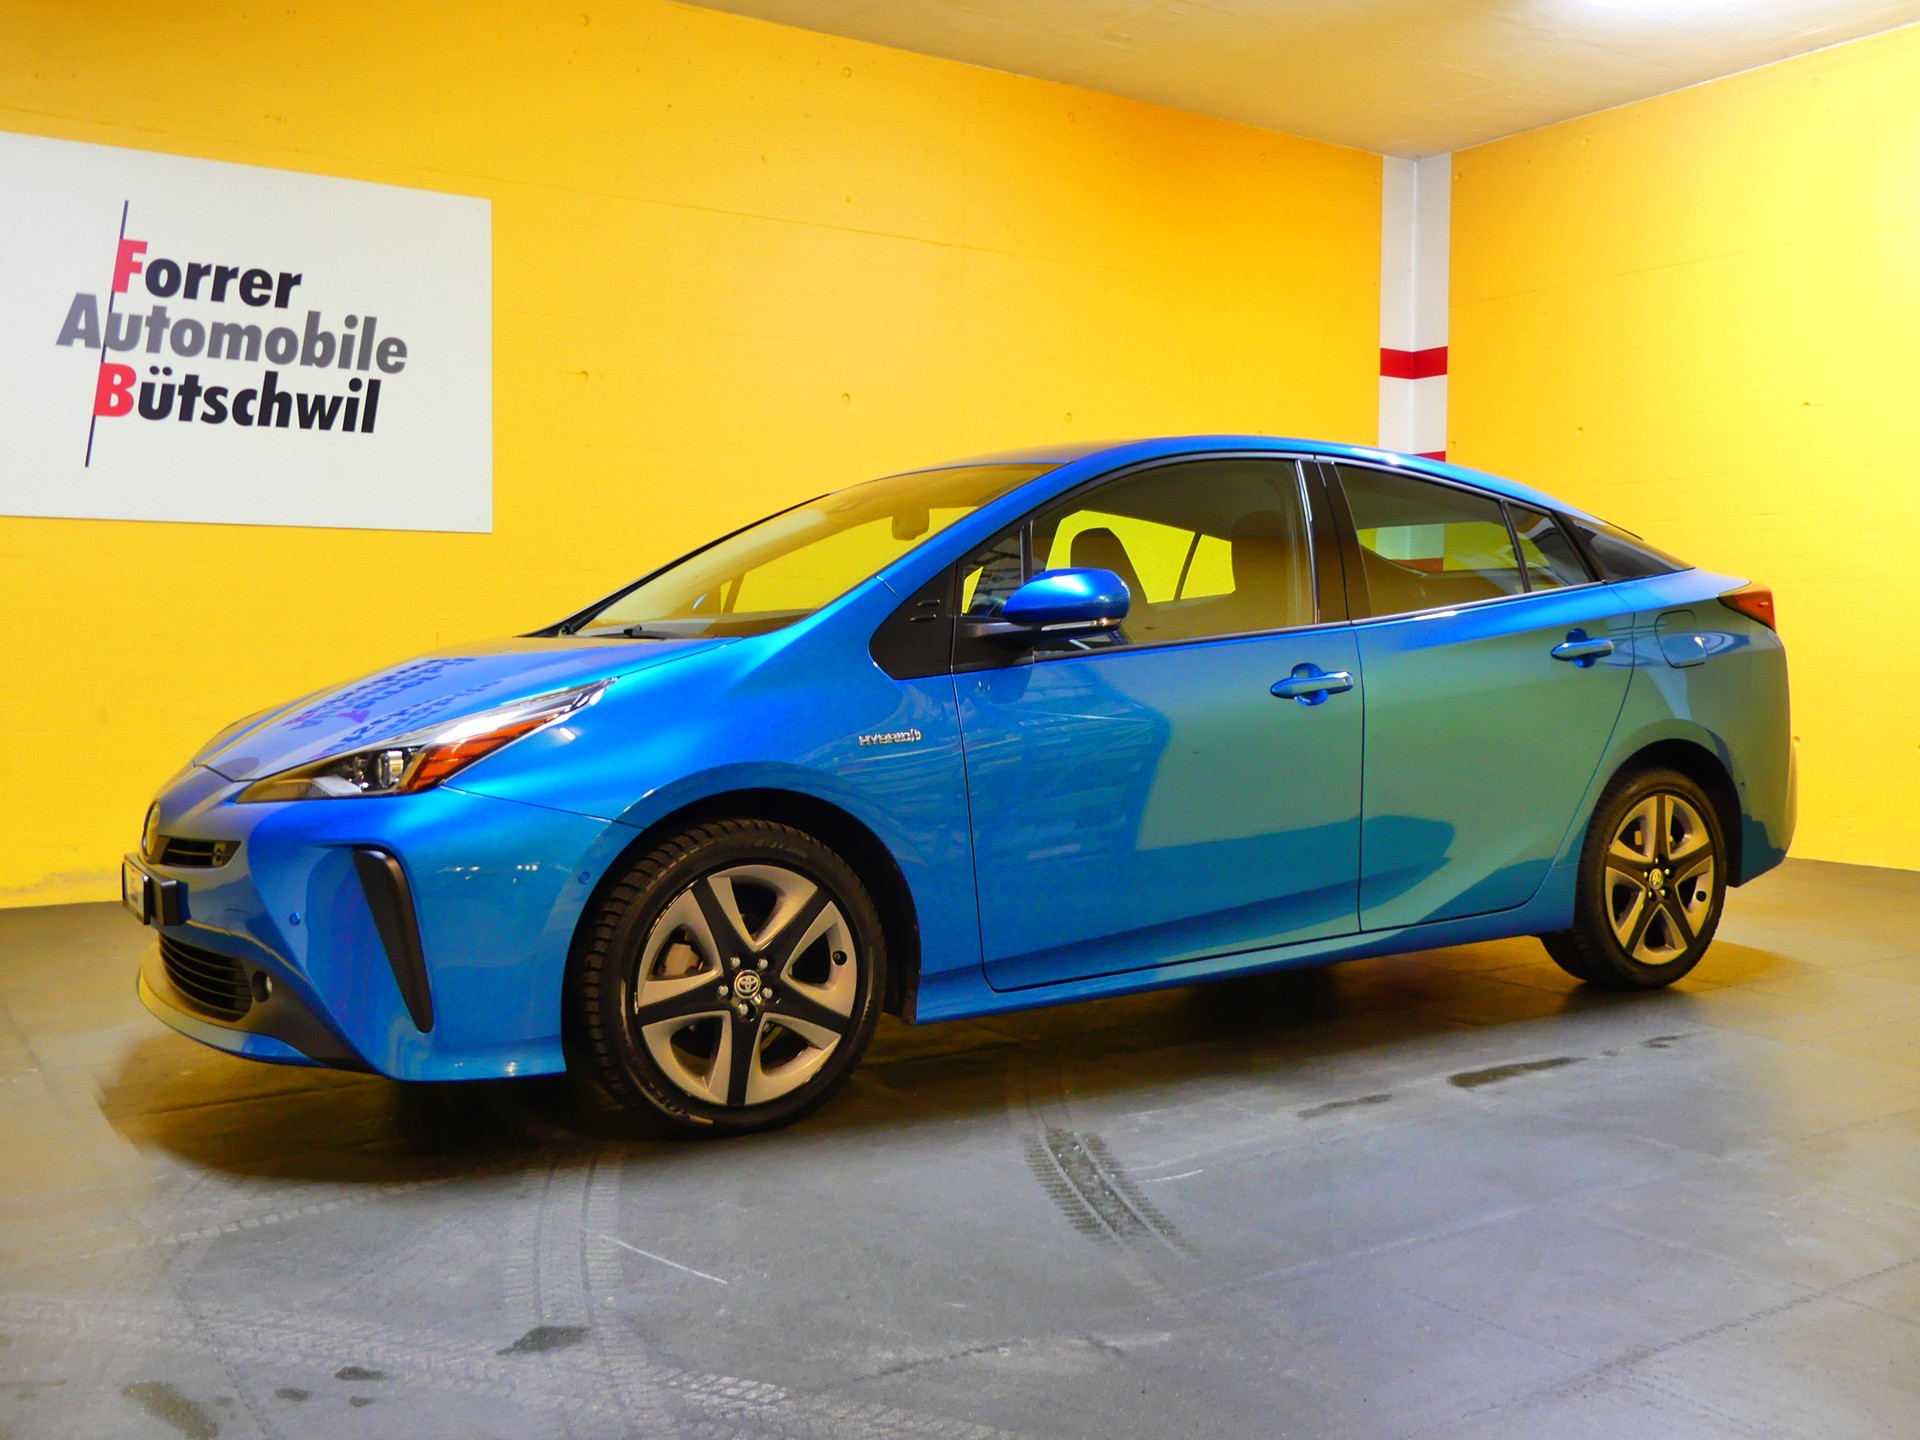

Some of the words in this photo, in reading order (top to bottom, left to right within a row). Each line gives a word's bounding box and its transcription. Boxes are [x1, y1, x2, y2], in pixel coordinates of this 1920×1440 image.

[111, 238, 302, 309] Forrer
[55, 292, 408, 374] Automobile
[93, 362, 382, 434] Bütschwil
